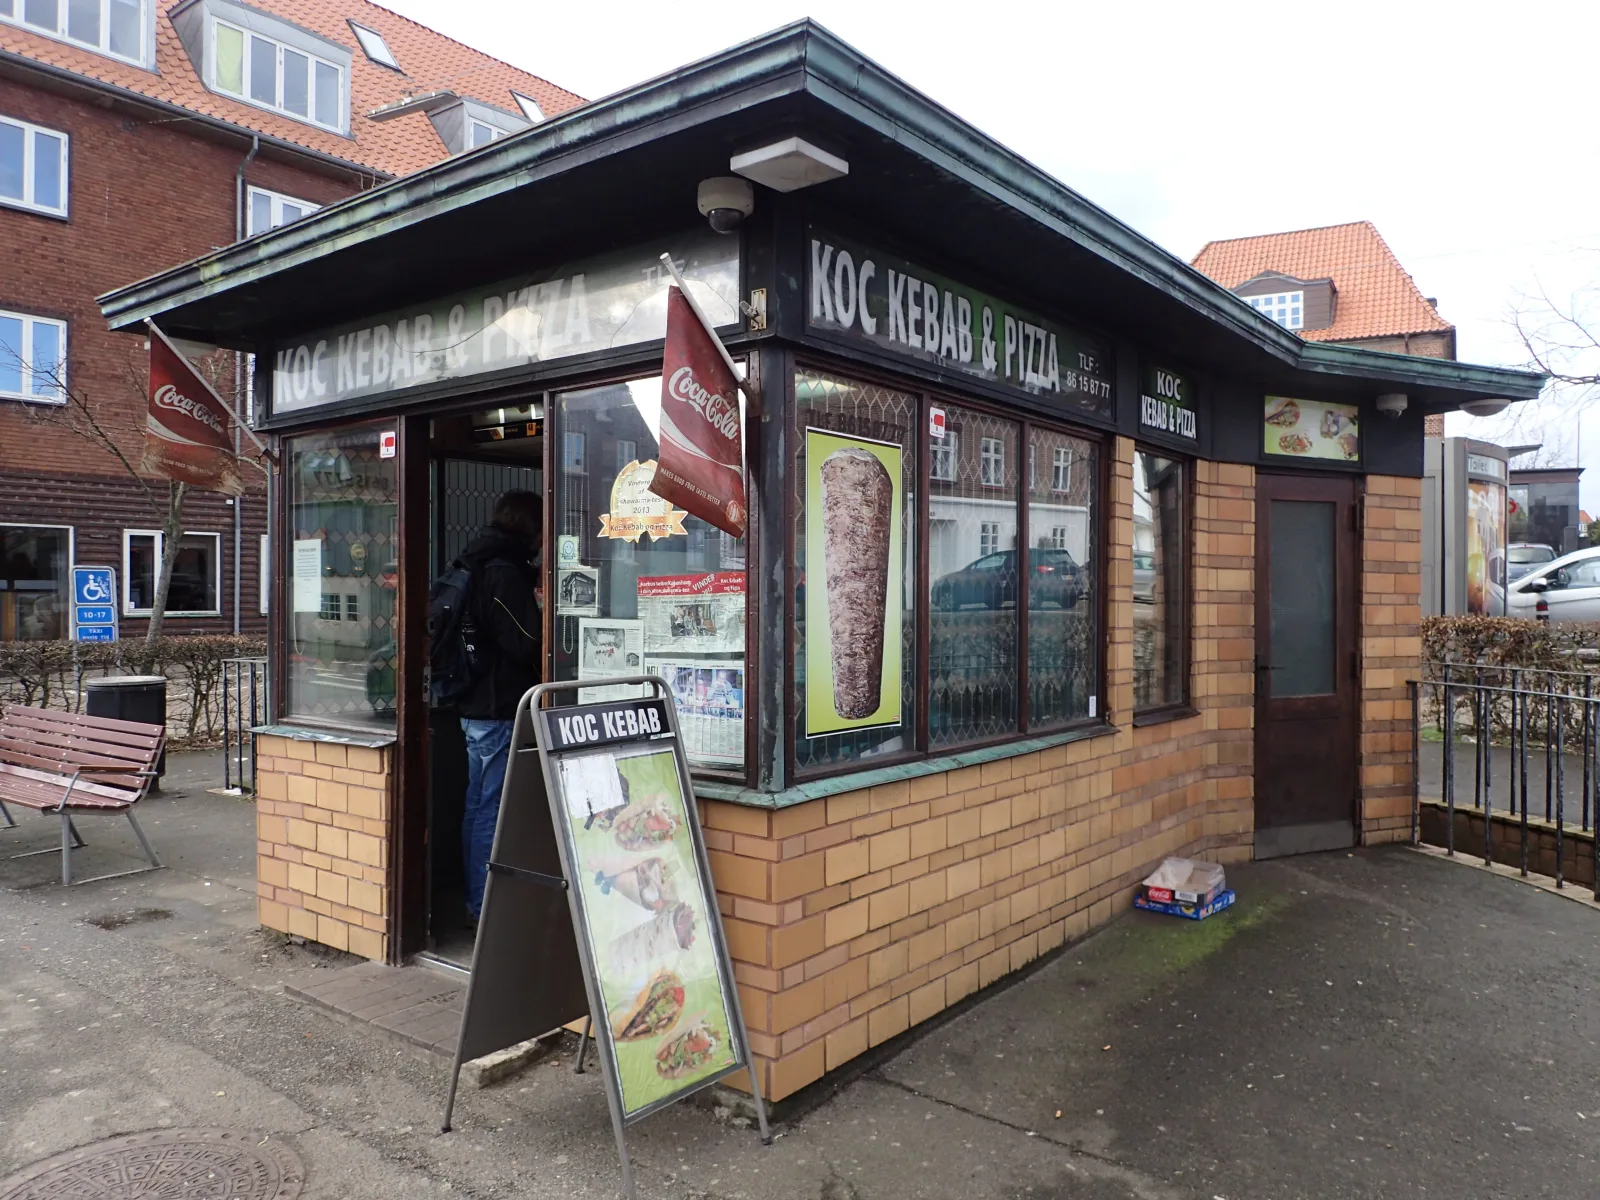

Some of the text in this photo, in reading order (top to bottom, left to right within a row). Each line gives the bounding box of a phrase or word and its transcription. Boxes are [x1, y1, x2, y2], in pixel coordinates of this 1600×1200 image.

[811, 239, 1061, 394] KOC KEBAB & PIZZA
[275, 339, 331, 405] KOC
[337, 315, 433, 394] KEBAB
[447, 304, 469, 368] &
[1066, 370, 1110, 399] 86 15 87 77
[1157, 370, 1181, 400] KOC
[1141, 394, 1197, 439] KEBAB & PIZZA
[660, 467, 674, 480] MAKES
[673, 475, 685, 486] GOOD
[684, 481, 696, 492] FOOD
[692, 573, 715, 591] VINDER
[84, 611, 106, 619] 10-17
[558, 707, 662, 745] KOC KEBAB
